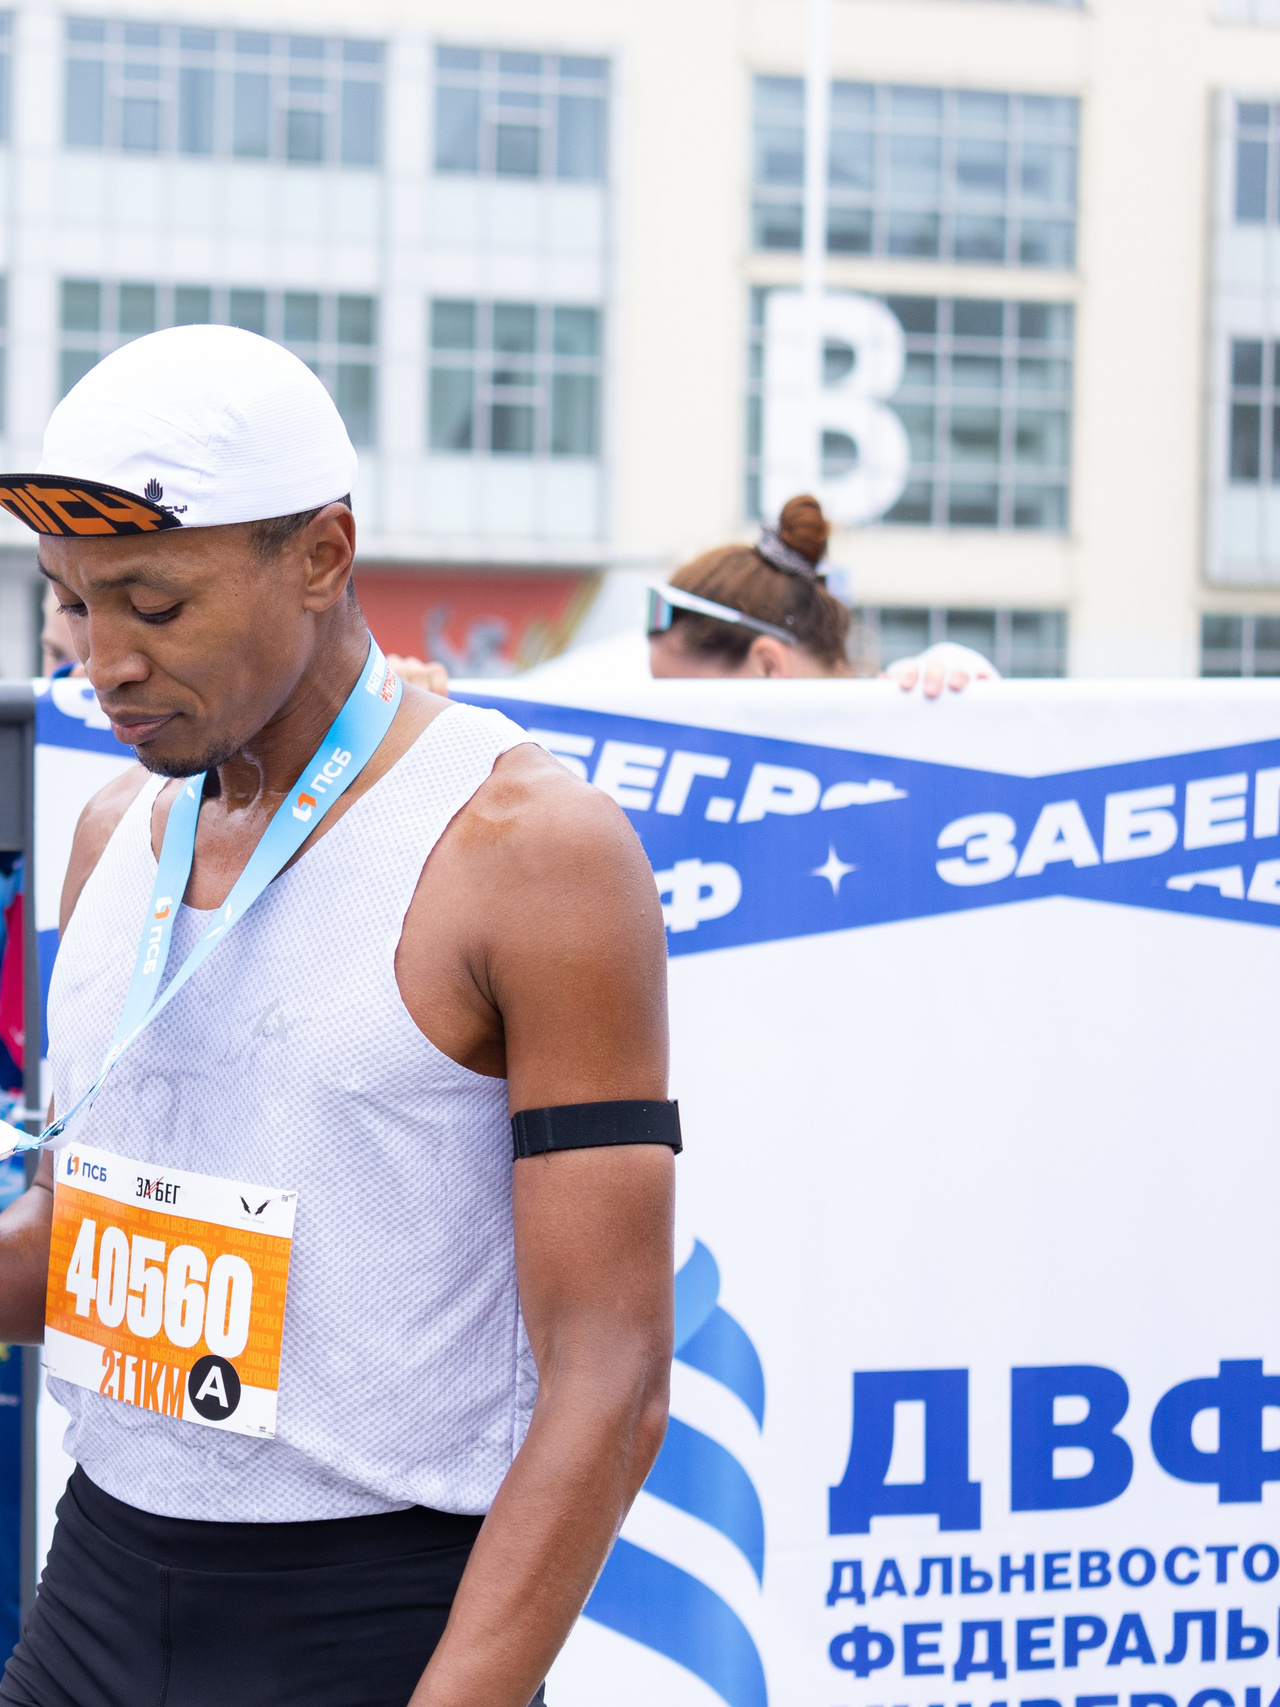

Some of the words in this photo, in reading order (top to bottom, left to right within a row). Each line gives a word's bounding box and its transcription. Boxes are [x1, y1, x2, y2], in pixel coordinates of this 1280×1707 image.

[309, 747, 352, 794] ПСБ
[143, 925, 163, 976] ПСБ
[82, 1161, 108, 1183] ПСБ
[136, 1177, 181, 1205] ЗАБЕГ
[66, 1218, 253, 1358] 40560
[828, 1359, 1280, 1536] ДВФ
[825, 1542, 1280, 1607] ДАЛЬНЕВОСТО
[827, 1606, 1280, 1682] ФЕДЕРАЛЬ
